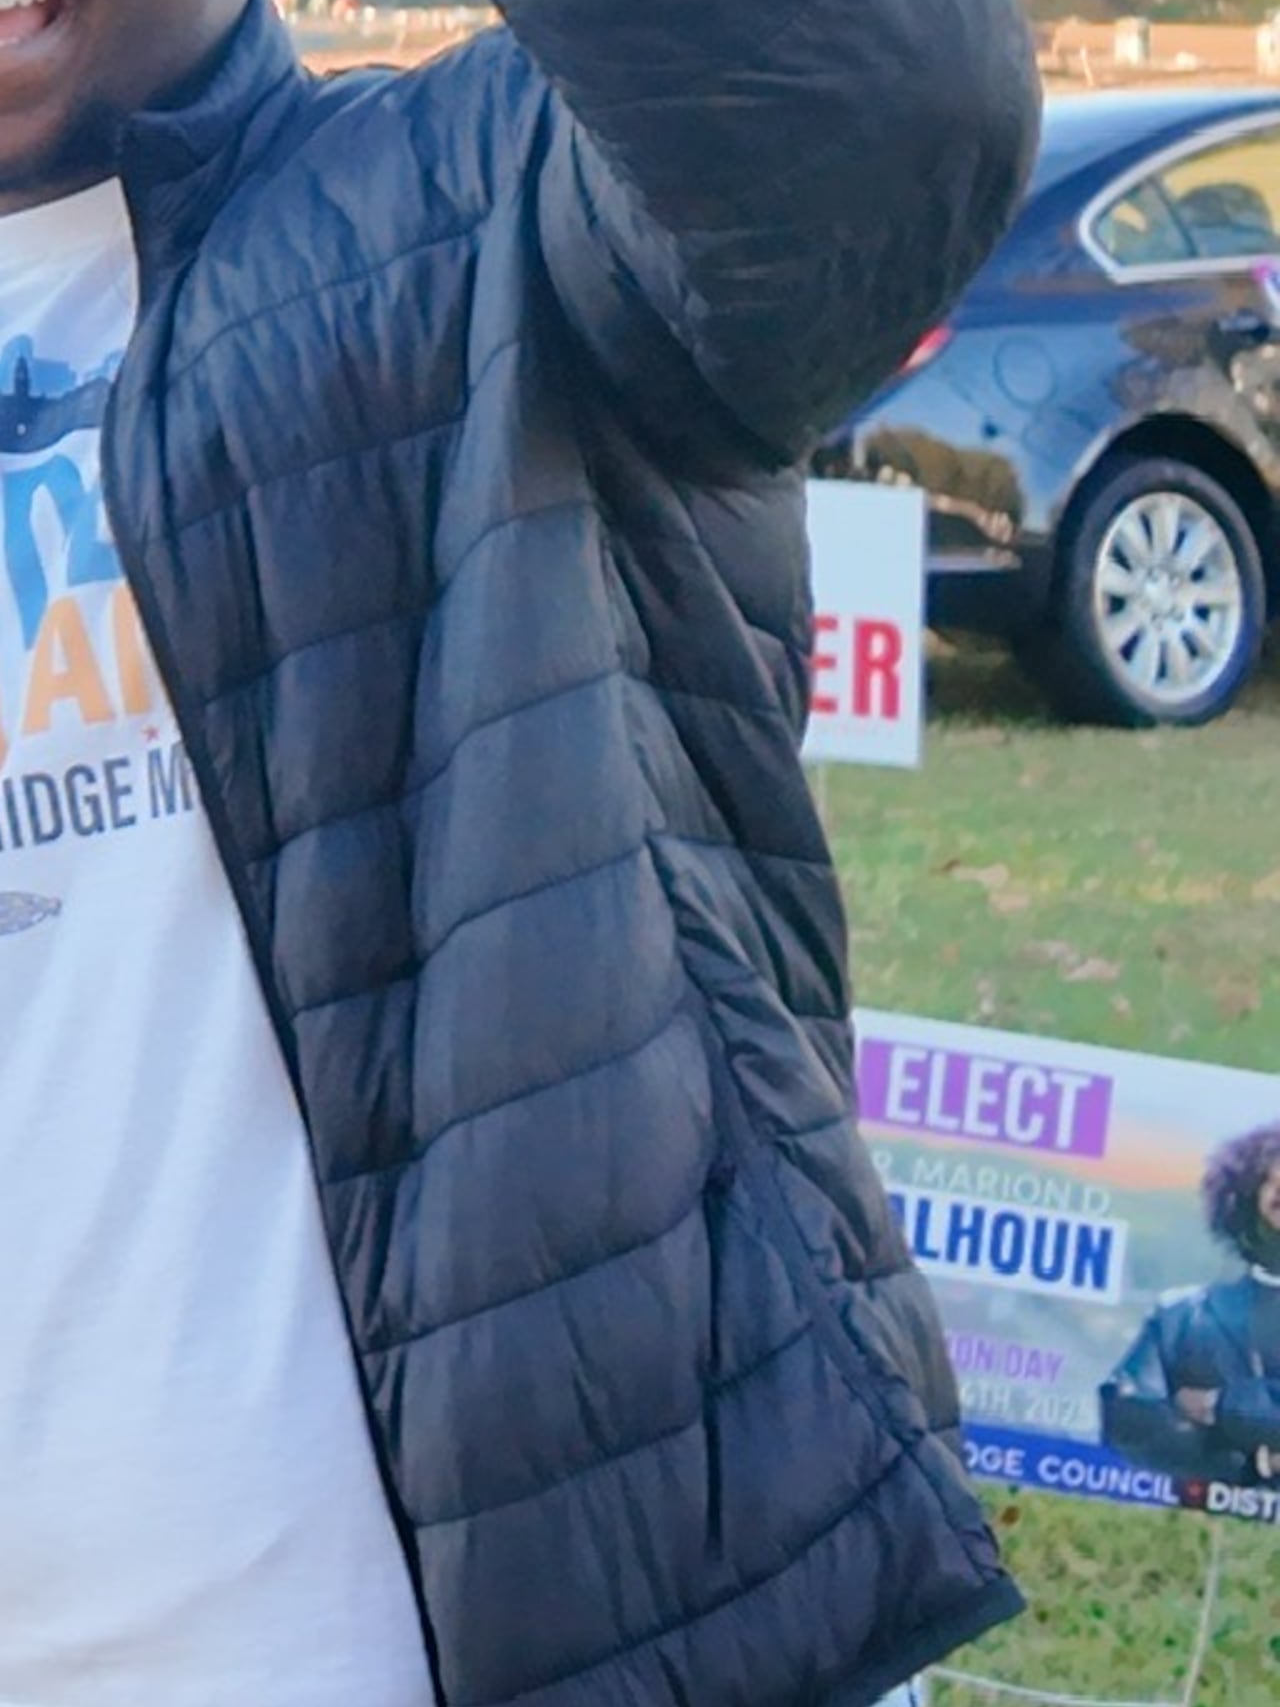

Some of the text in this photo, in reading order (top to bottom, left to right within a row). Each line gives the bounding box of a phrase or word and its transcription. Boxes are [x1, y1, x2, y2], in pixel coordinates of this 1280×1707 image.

[885, 1045, 1092, 1150] ELECT
[912, 1156, 1070, 1209] MARION
[1037, 1454, 1180, 1505] COUNCIL
[1207, 1480, 1280, 1523] DIST
